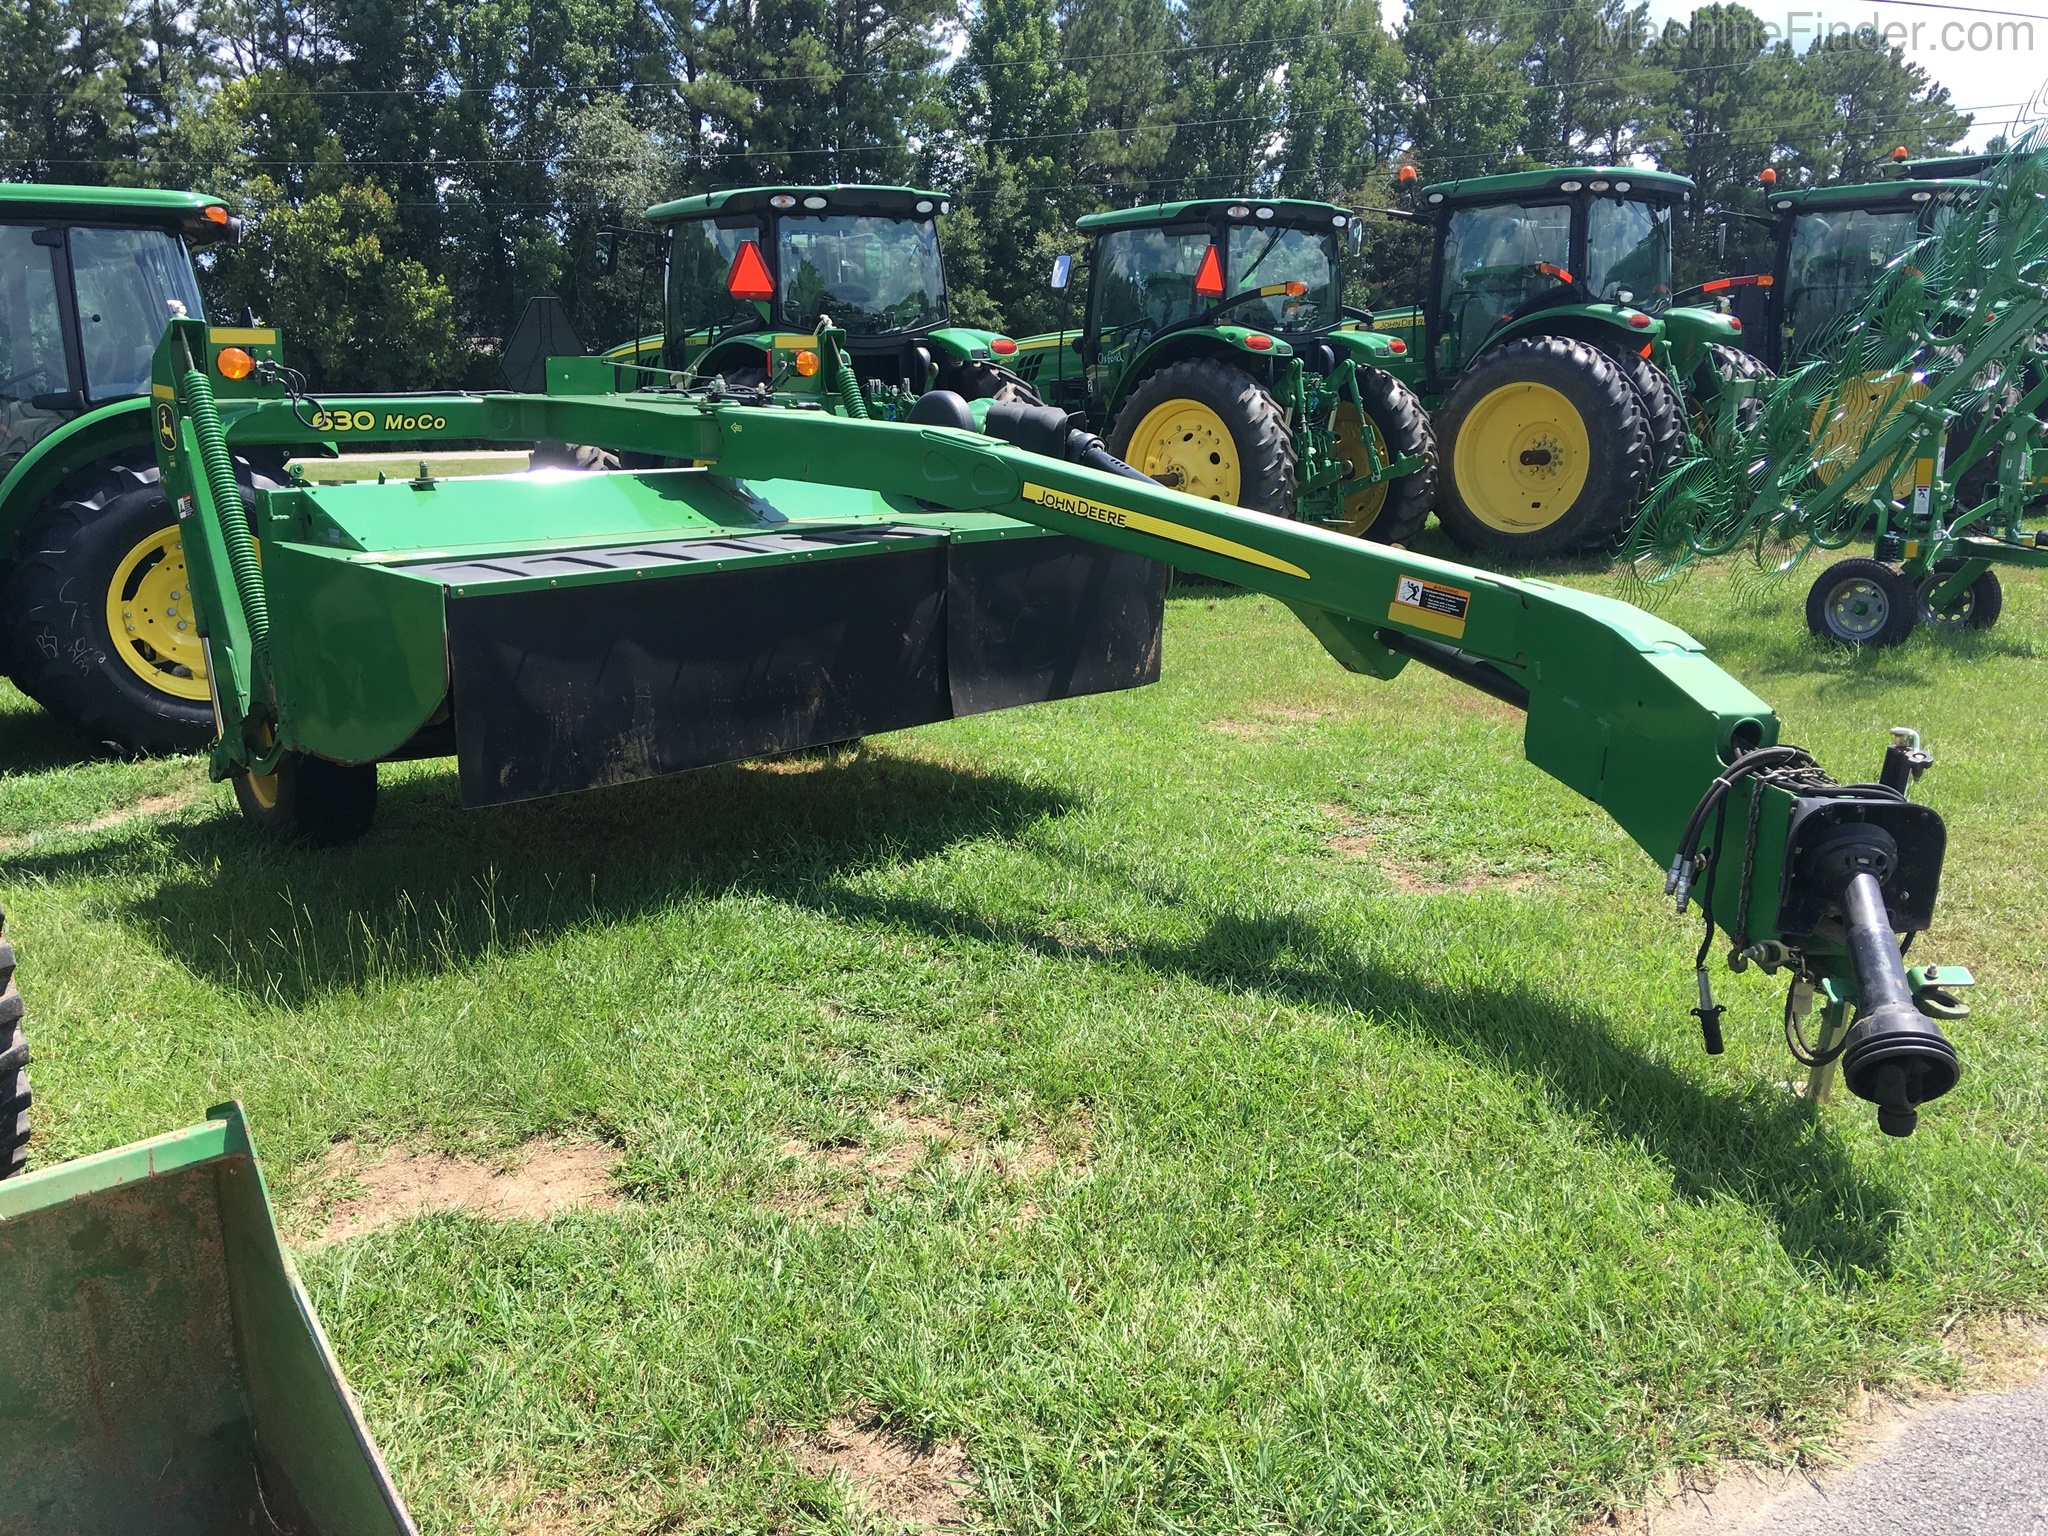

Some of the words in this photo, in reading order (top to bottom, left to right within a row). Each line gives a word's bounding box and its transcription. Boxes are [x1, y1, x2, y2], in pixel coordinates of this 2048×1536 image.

[1097, 350, 1125, 365] Oxford
[312, 410, 376, 431] 630
[384, 413, 447, 430] MoCo
[1037, 490, 1076, 513] JOHN
[1077, 500, 1128, 527] DEERE
